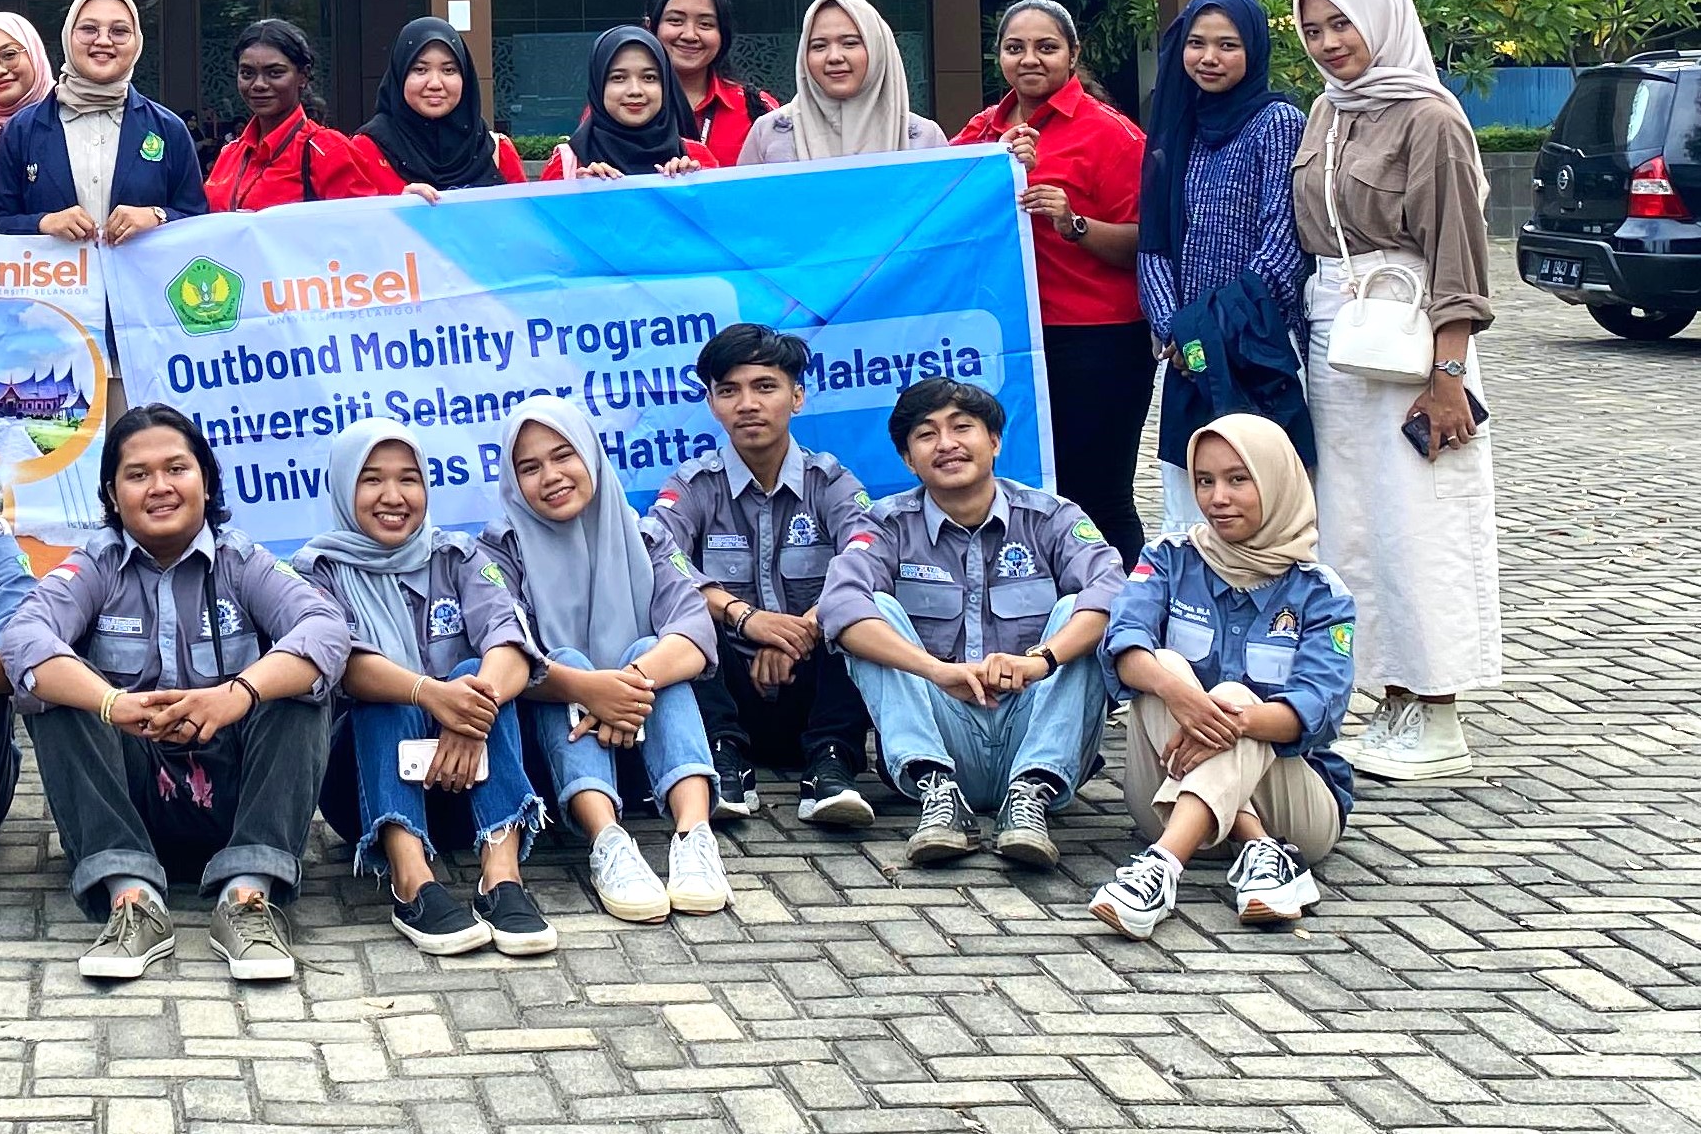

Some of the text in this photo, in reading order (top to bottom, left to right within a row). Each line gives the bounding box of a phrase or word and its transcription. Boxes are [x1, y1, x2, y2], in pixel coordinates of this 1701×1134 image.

[34, 287, 89, 296] SELANGOR
[262, 252, 422, 315] unisel
[350, 304, 423, 319] SELANGOR
[167, 311, 717, 394] Outbond Mobility Program
[583, 363, 708, 417] (UNIS
[801, 337, 984, 394] Malaysia
